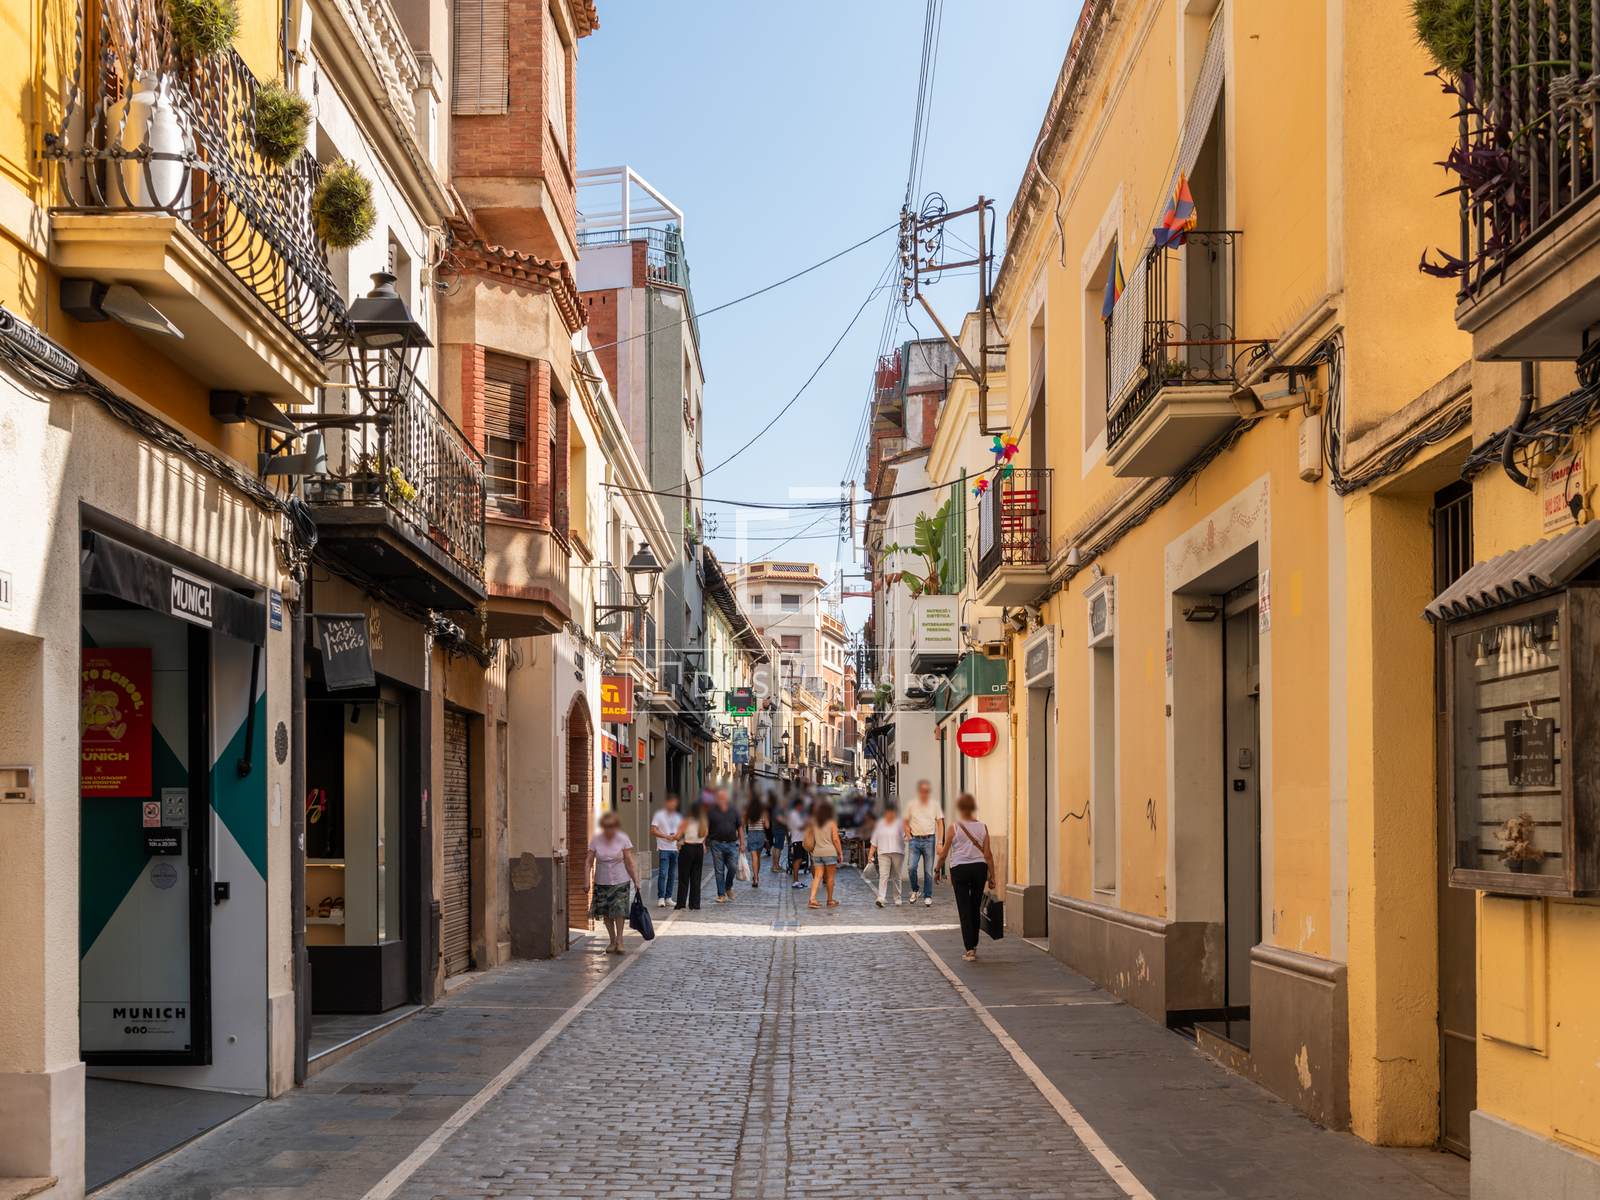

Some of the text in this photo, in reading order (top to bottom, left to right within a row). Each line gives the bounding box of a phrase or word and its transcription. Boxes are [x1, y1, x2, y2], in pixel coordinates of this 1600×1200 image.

[171, 576, 212, 617] MUNICH
[328, 620, 352, 633] un
[324, 627, 356, 661] paso
[333, 633, 365, 653] más
[102, 669, 145, 710] SCHOOL
[112, 1007, 186, 1019] MUNICH
